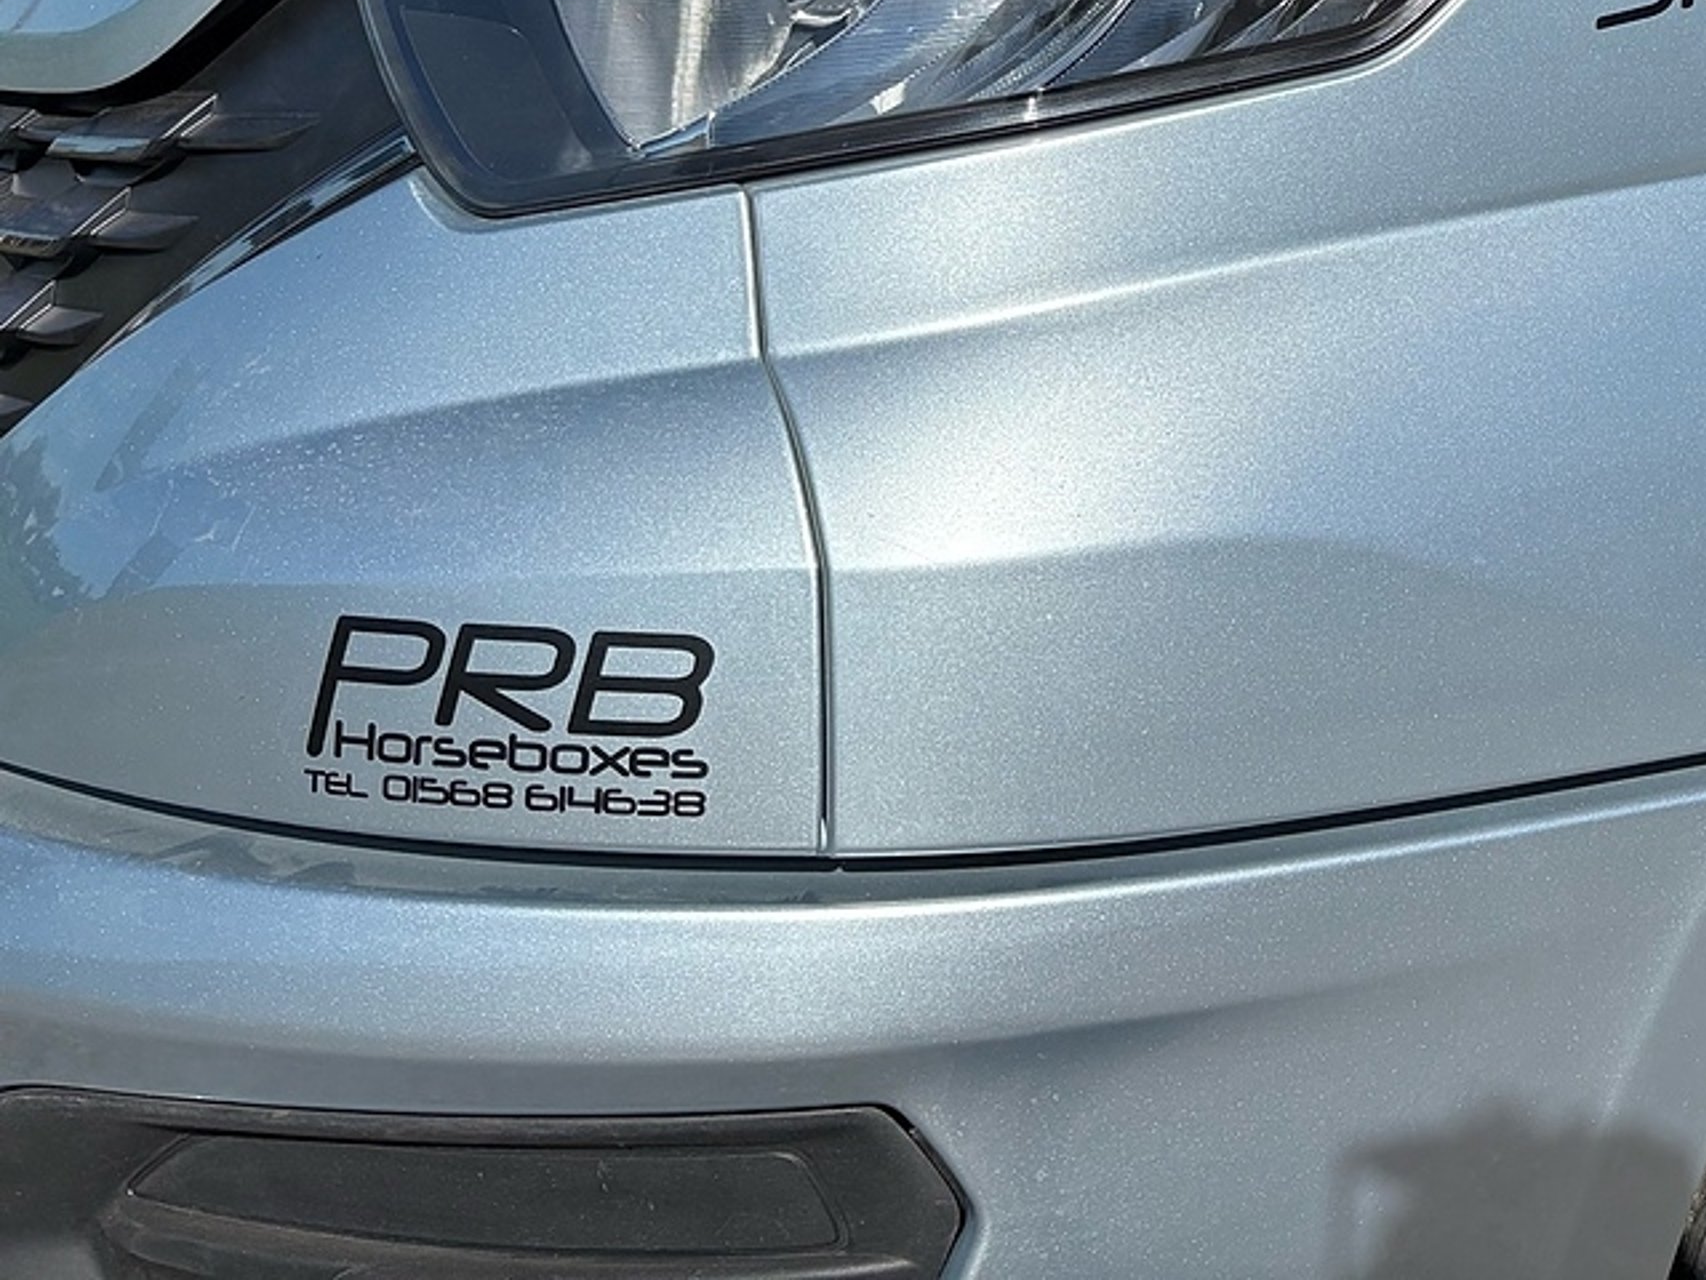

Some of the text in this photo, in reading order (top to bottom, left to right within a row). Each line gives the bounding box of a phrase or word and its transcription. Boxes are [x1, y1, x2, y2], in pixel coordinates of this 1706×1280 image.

[306, 614, 715, 758] PRB
[333, 719, 709, 779] Horseboxes
[382, 774, 514, 809] 01568
[524, 784, 707, 818] 614638
